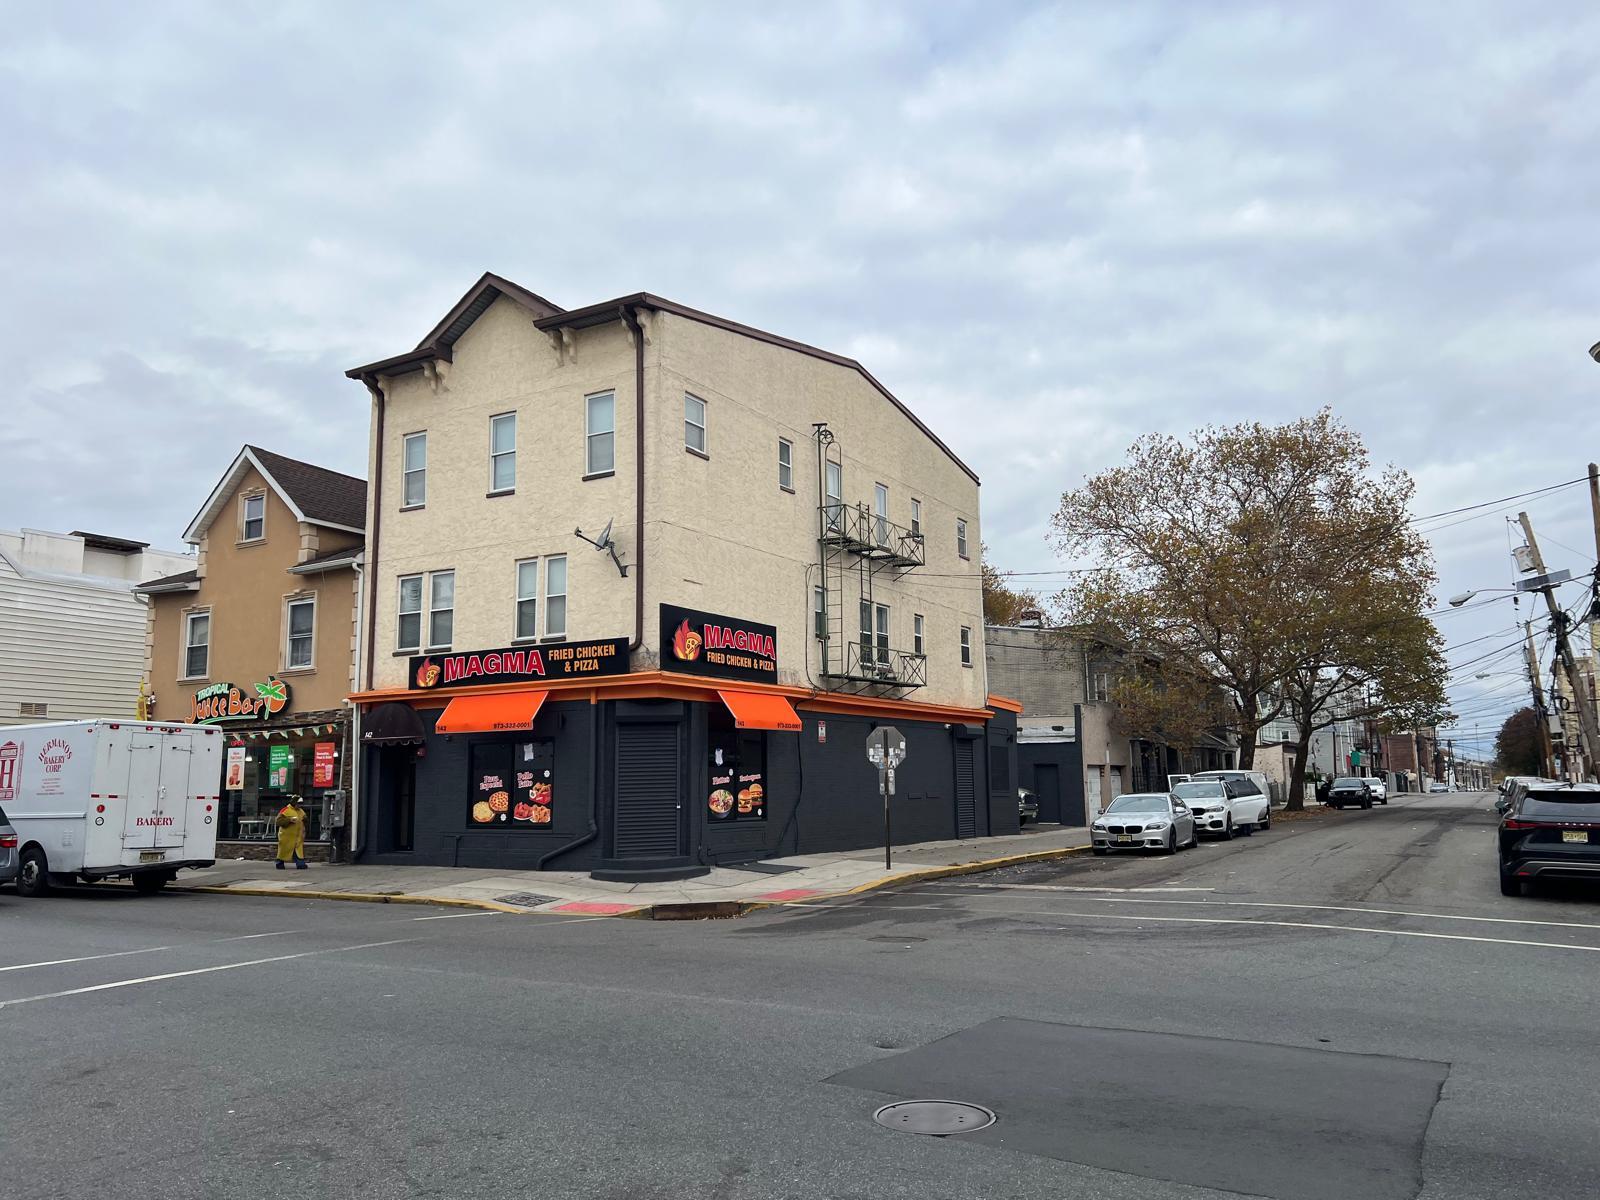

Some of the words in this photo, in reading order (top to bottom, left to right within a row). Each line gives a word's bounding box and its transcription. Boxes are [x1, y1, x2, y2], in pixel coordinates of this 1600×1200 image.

[704, 623, 775, 660] MAGMA
[548, 648, 574, 661] FRIED
[576, 644, 615, 658] CHICKEN
[707, 651, 725, 664] FRIED
[726, 654, 752, 668] CHICKEN
[753, 659, 758, 670] &
[759, 660, 775, 672] PIZZA
[443, 649, 546, 683] MAGMA
[564, 661, 572, 673] &
[573, 659, 599, 672] PIZZA
[197, 683, 230, 701] TROPICAL
[38, 738, 72, 762] HERMANOS
[43, 756, 65, 764] BAKERY
[136, 817, 175, 826] BAKERY
